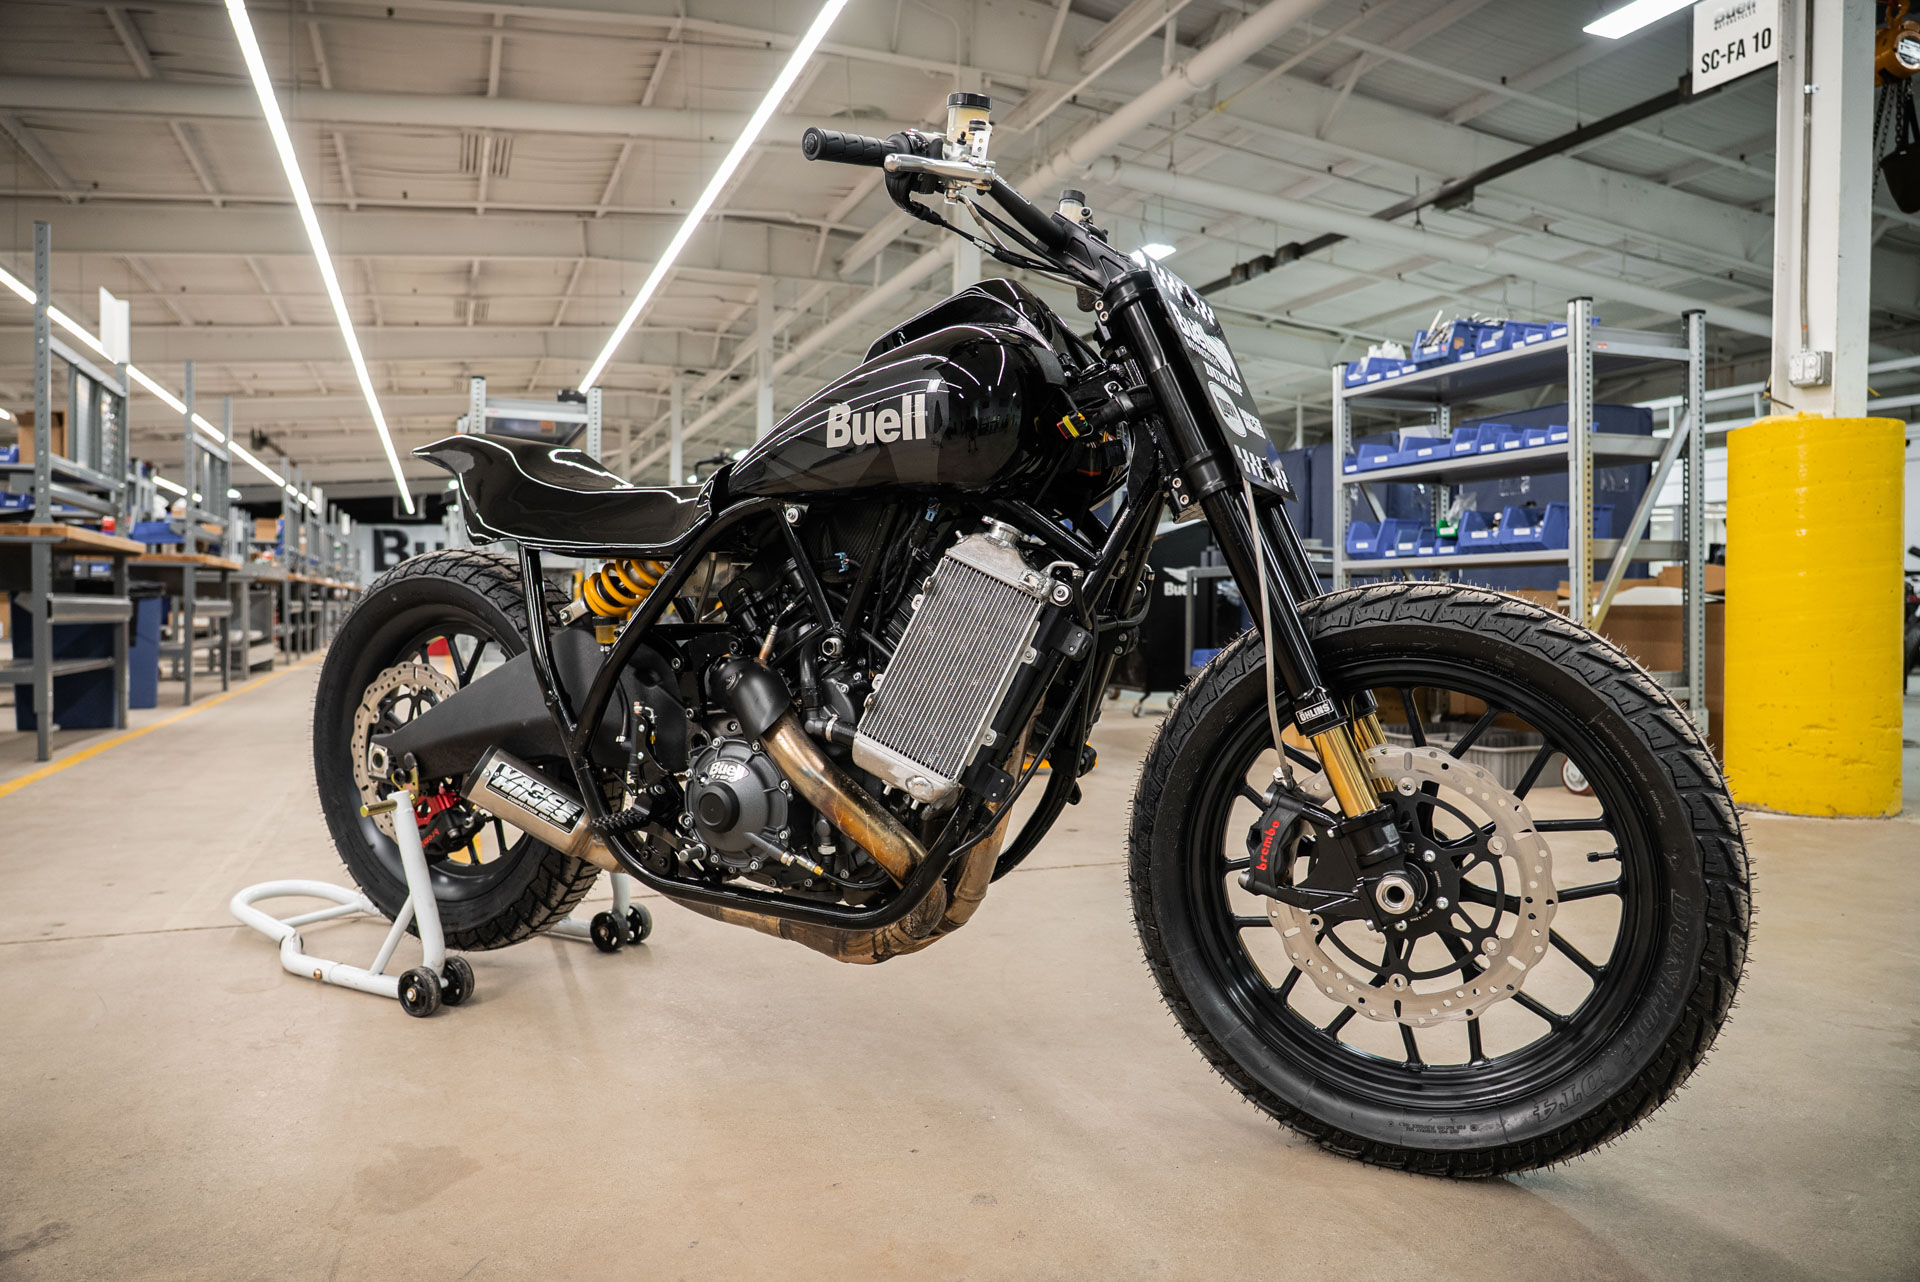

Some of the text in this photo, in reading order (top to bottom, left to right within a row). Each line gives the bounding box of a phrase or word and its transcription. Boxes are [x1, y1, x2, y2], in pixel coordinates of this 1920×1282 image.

[1701, 27, 1772, 74] SC-FA 10
[827, 393, 926, 448] Buell
[491, 776, 571, 823] HINES
[500, 765, 580, 816] VANCE
[1256, 820, 1280, 871] brembo
[1533, 1065, 1607, 1122] DT4
